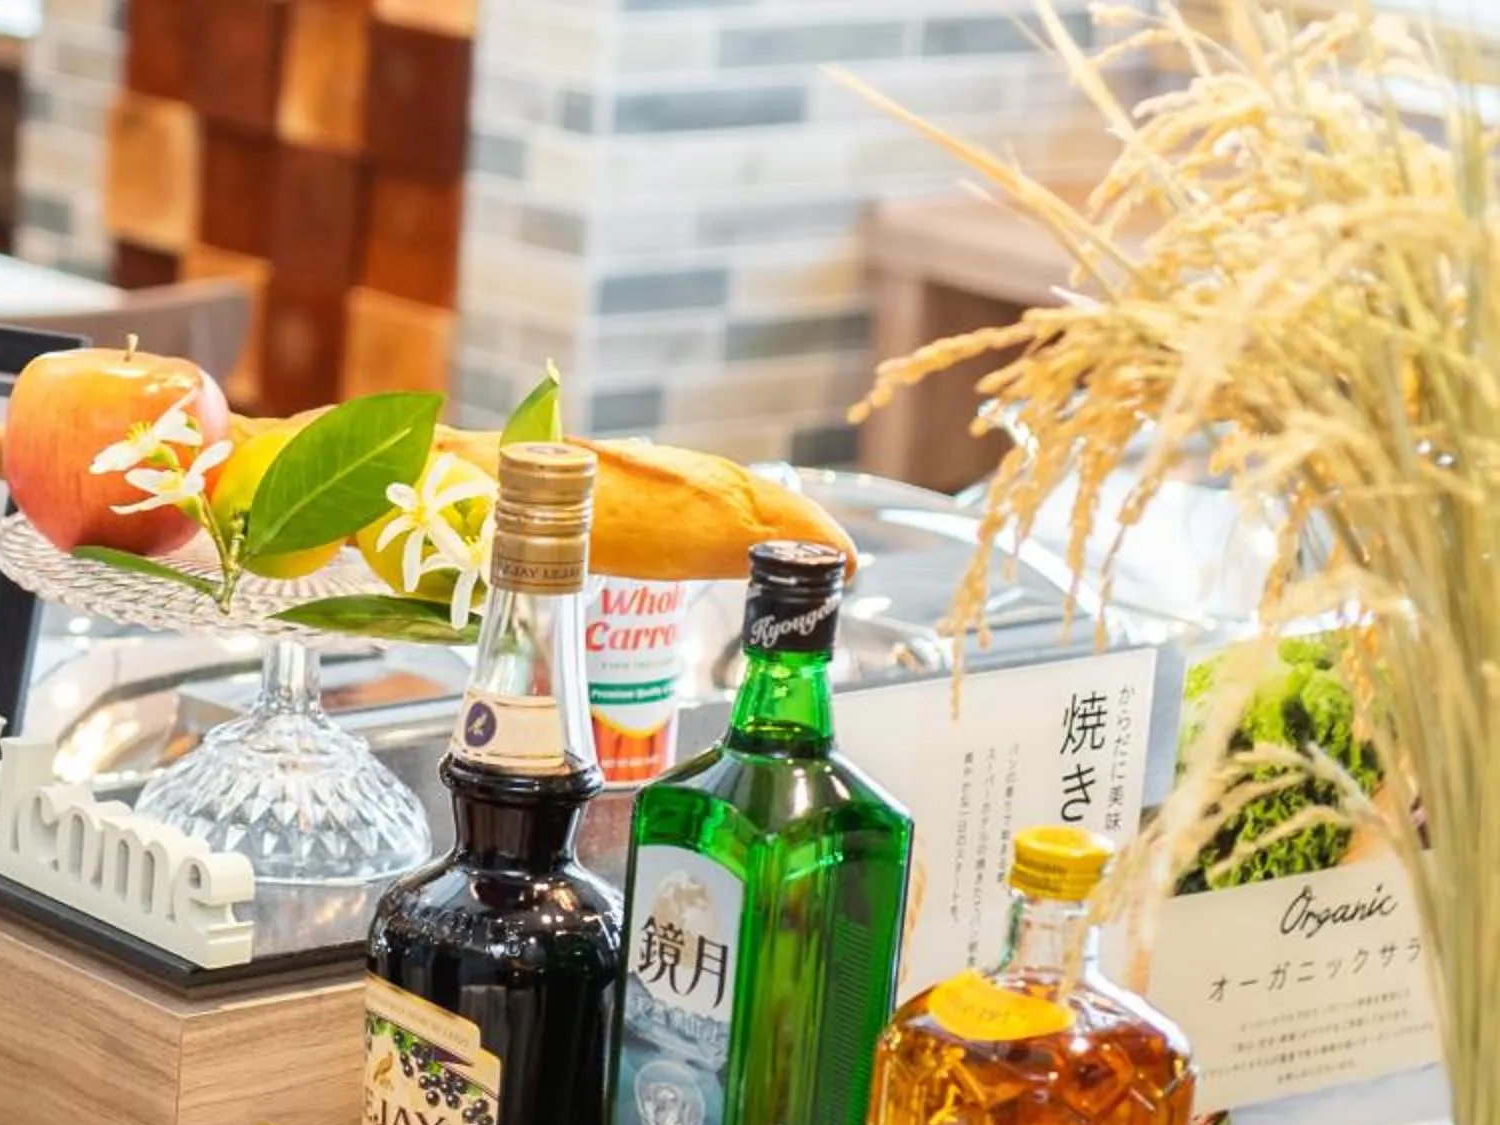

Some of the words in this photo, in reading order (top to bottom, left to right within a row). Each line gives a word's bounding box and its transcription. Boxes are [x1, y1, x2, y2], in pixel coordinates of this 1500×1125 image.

[601, 585, 681, 617] Whol
[585, 620, 679, 652] Carro
[1279, 882, 1399, 939] Organic
[637, 915, 729, 1009] 鏡月
